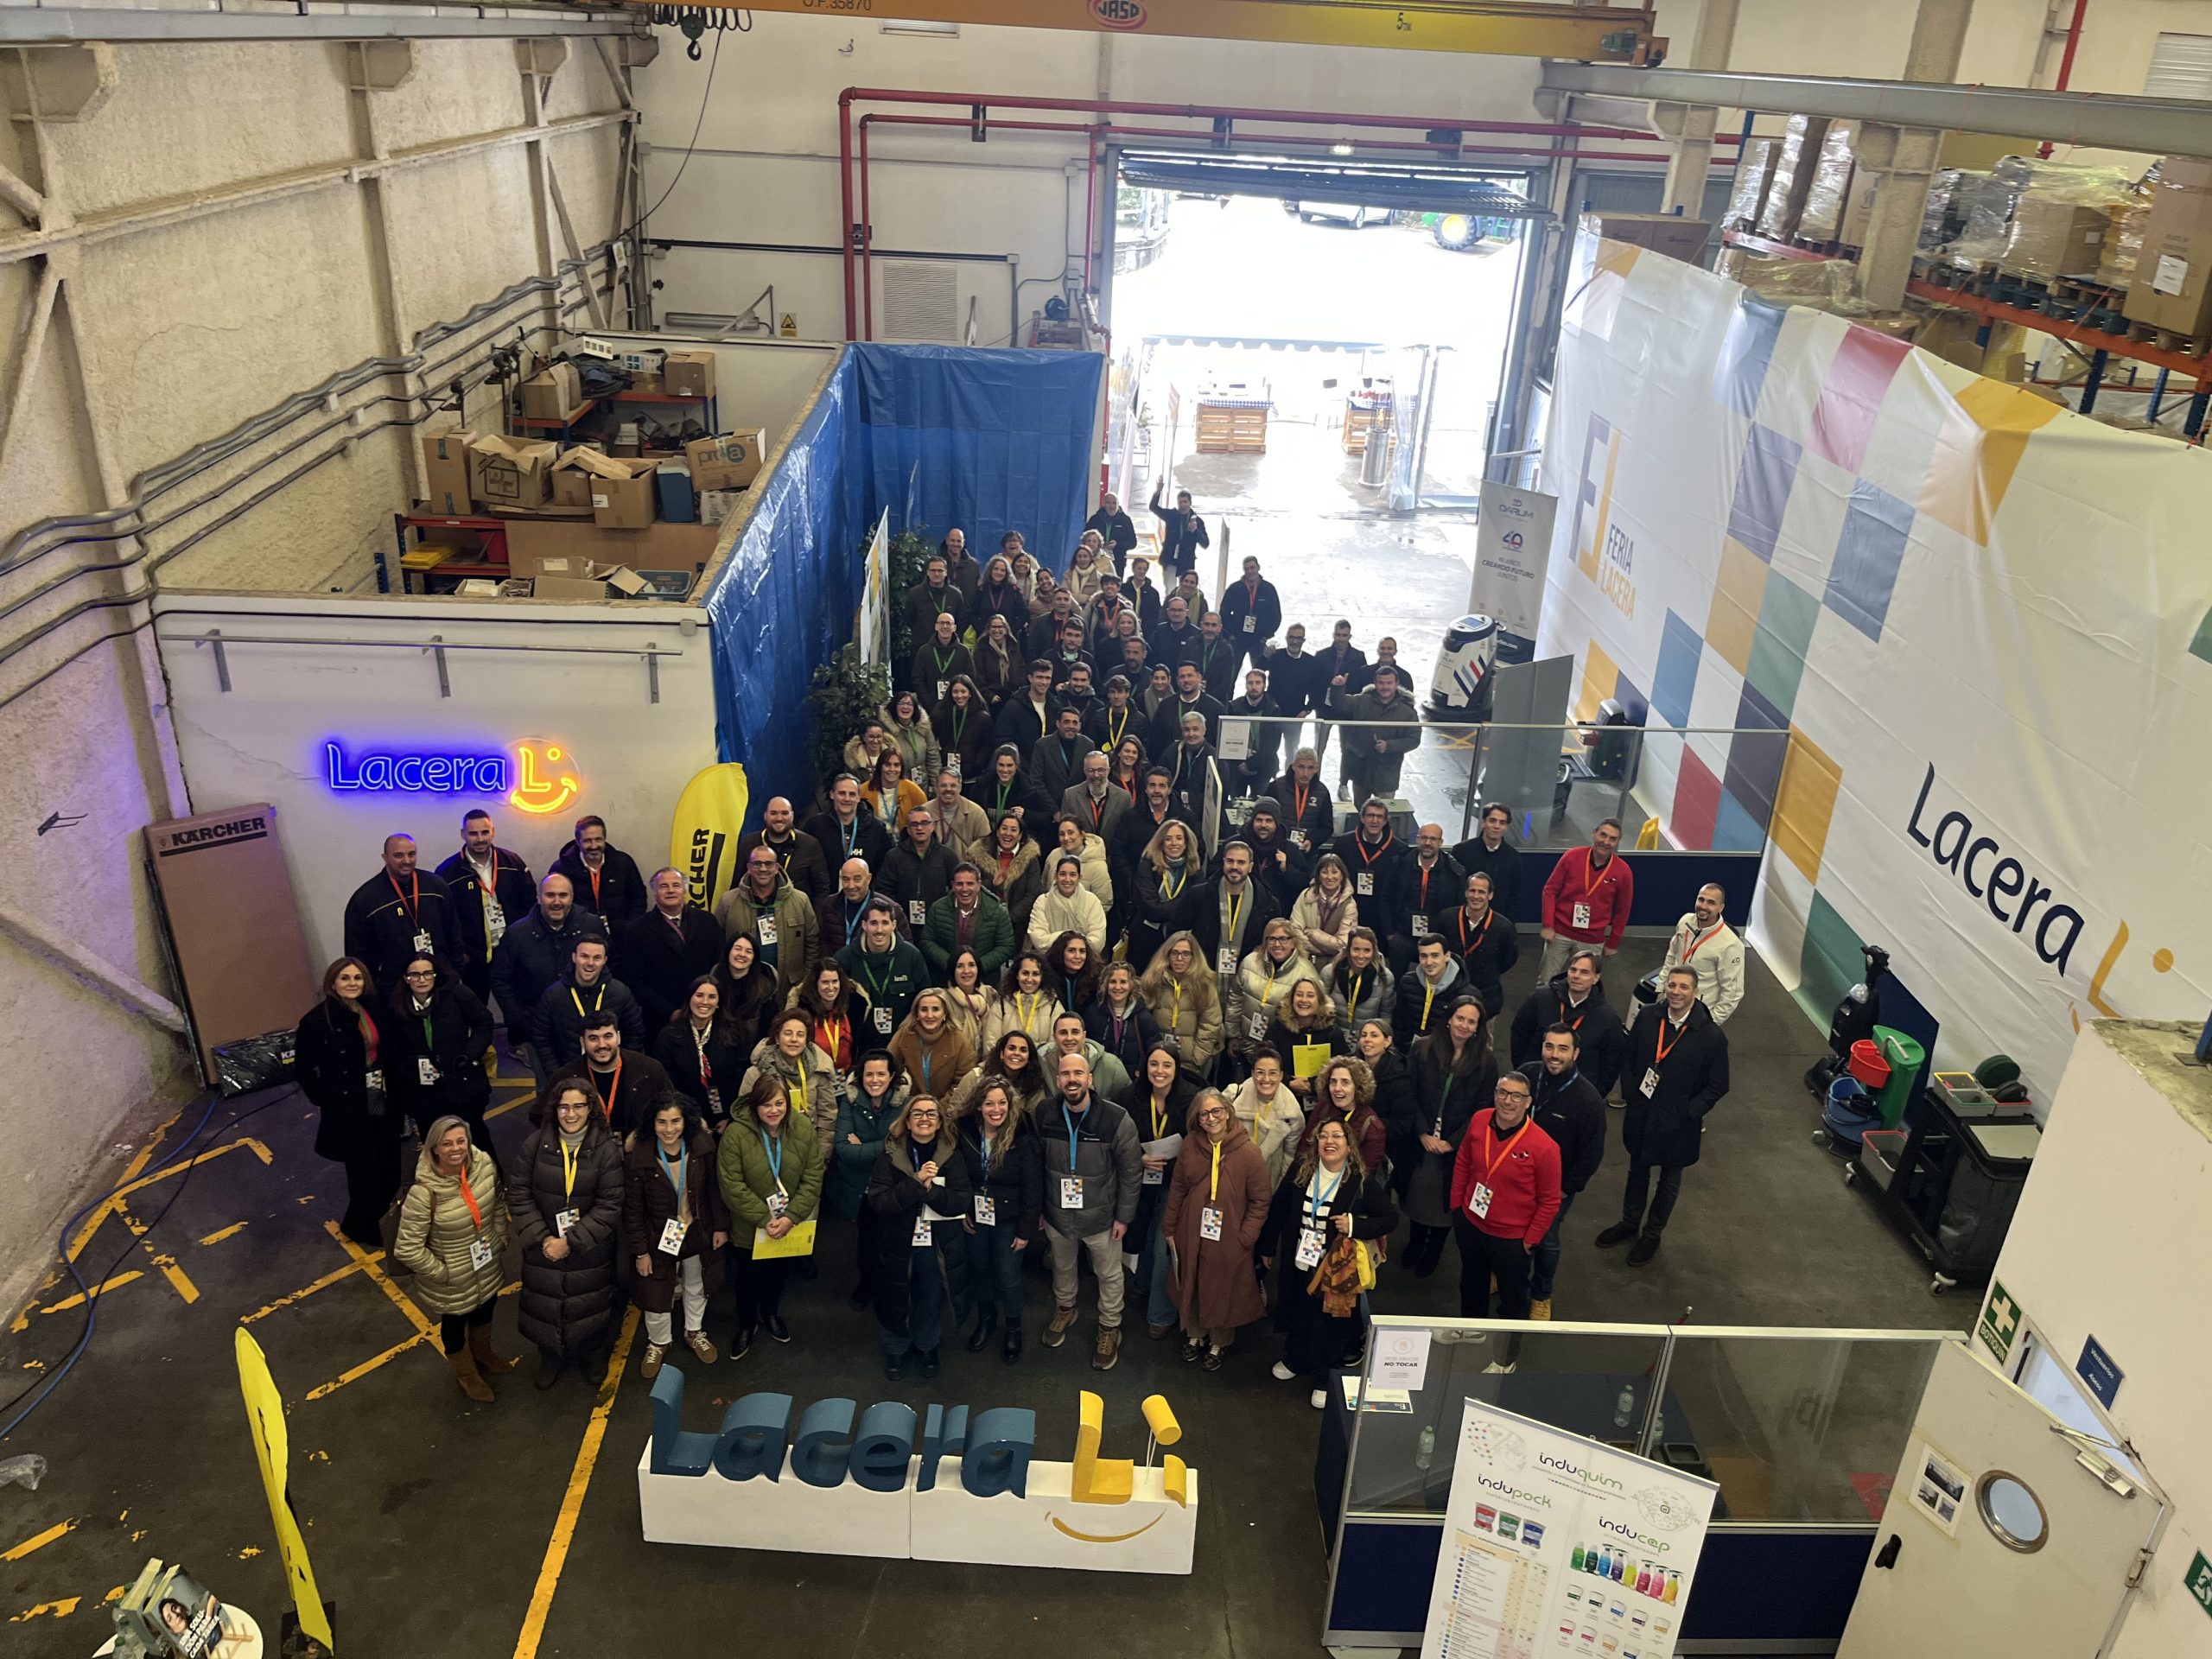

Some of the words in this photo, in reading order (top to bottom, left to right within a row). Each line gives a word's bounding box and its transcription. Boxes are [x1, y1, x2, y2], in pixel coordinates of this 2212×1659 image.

[1482, 559, 1510, 572] CREANDO
[1511, 567, 1535, 580] FUTURO
[1605, 524, 1634, 575] FERIA
[1600, 559, 1637, 620] LACERA
[327, 743, 507, 791] Lacera
[688, 828, 710, 910] RCHER
[1907, 761, 2085, 977] Lacera
[2088, 1373, 2102, 1391] Aseos
[2090, 1348, 2115, 1379] Vestuarios
[650, 1363, 1037, 1499] Lacera
[1539, 1452, 1624, 1491] induquim
